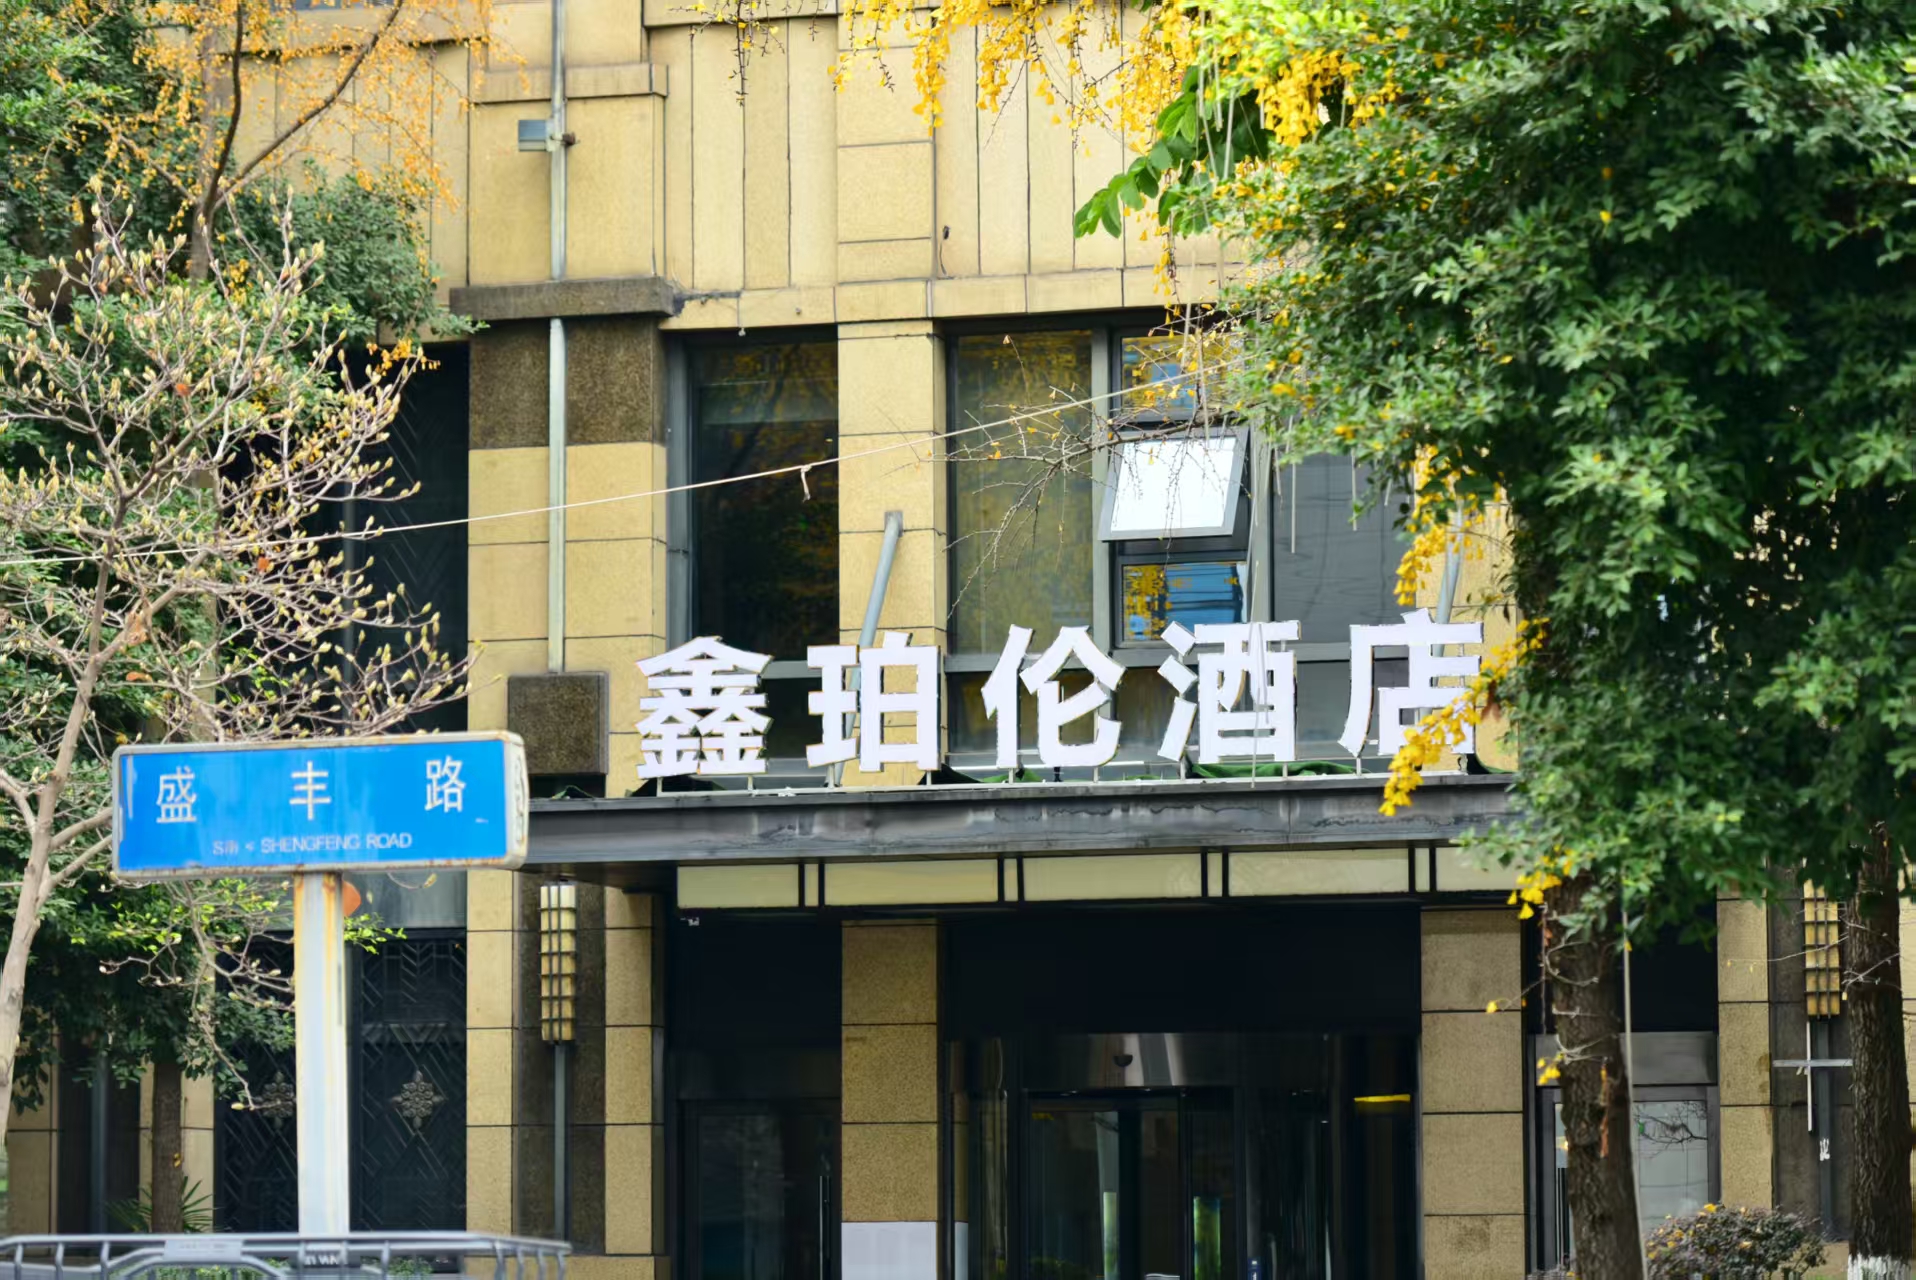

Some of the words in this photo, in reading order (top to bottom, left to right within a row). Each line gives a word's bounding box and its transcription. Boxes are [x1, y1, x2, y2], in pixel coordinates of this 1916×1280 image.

[635, 607, 1484, 780] 鑫珀伦酒店
[155, 754, 467, 824] 盛丰路
[260, 834, 361, 854] SHENGFENG
[365, 832, 413, 850] ROAD
